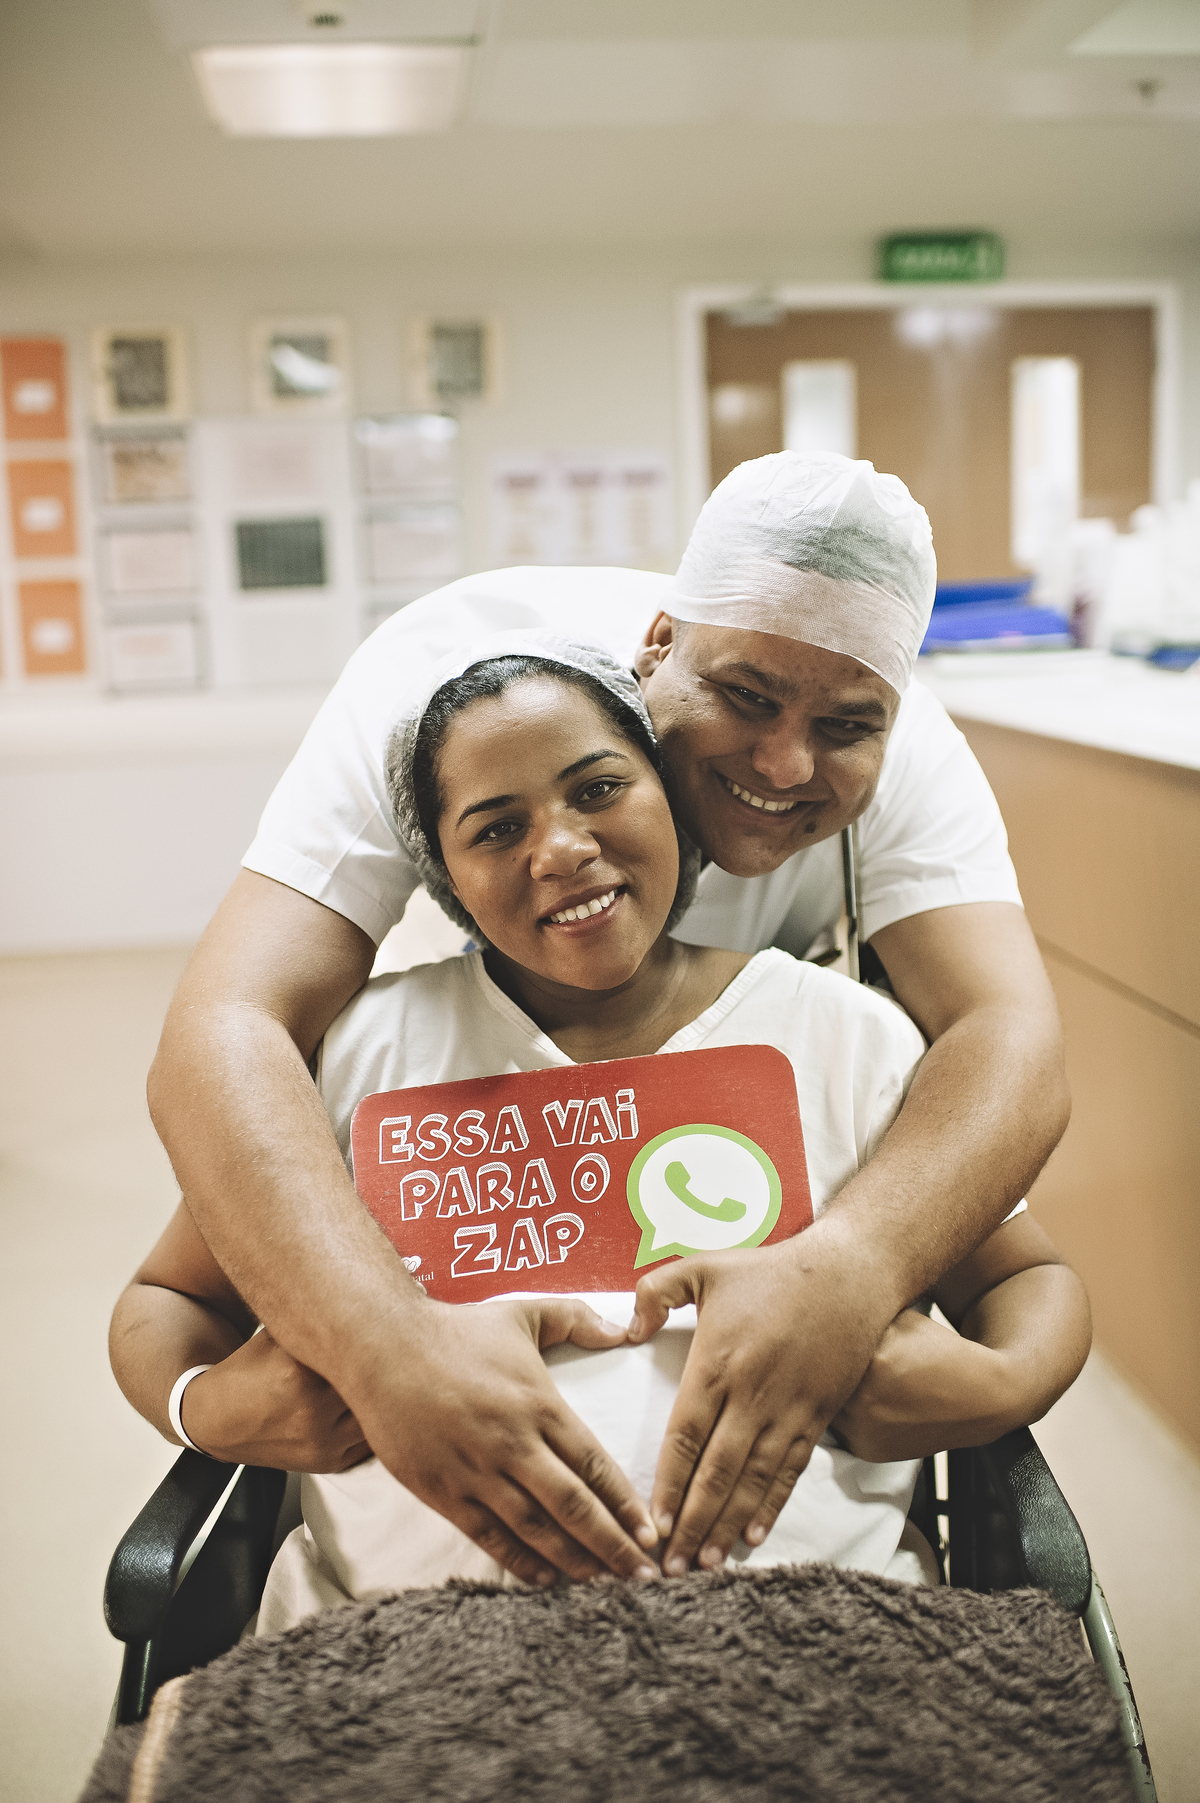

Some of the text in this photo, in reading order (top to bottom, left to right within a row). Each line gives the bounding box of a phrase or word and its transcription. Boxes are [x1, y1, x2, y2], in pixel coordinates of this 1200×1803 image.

[379, 1105, 529, 1164] ESSA
[400, 1153, 610, 1221] PARA O
[451, 1212, 585, 1278] ZAP
[412, 1271, 434, 1282] atal
